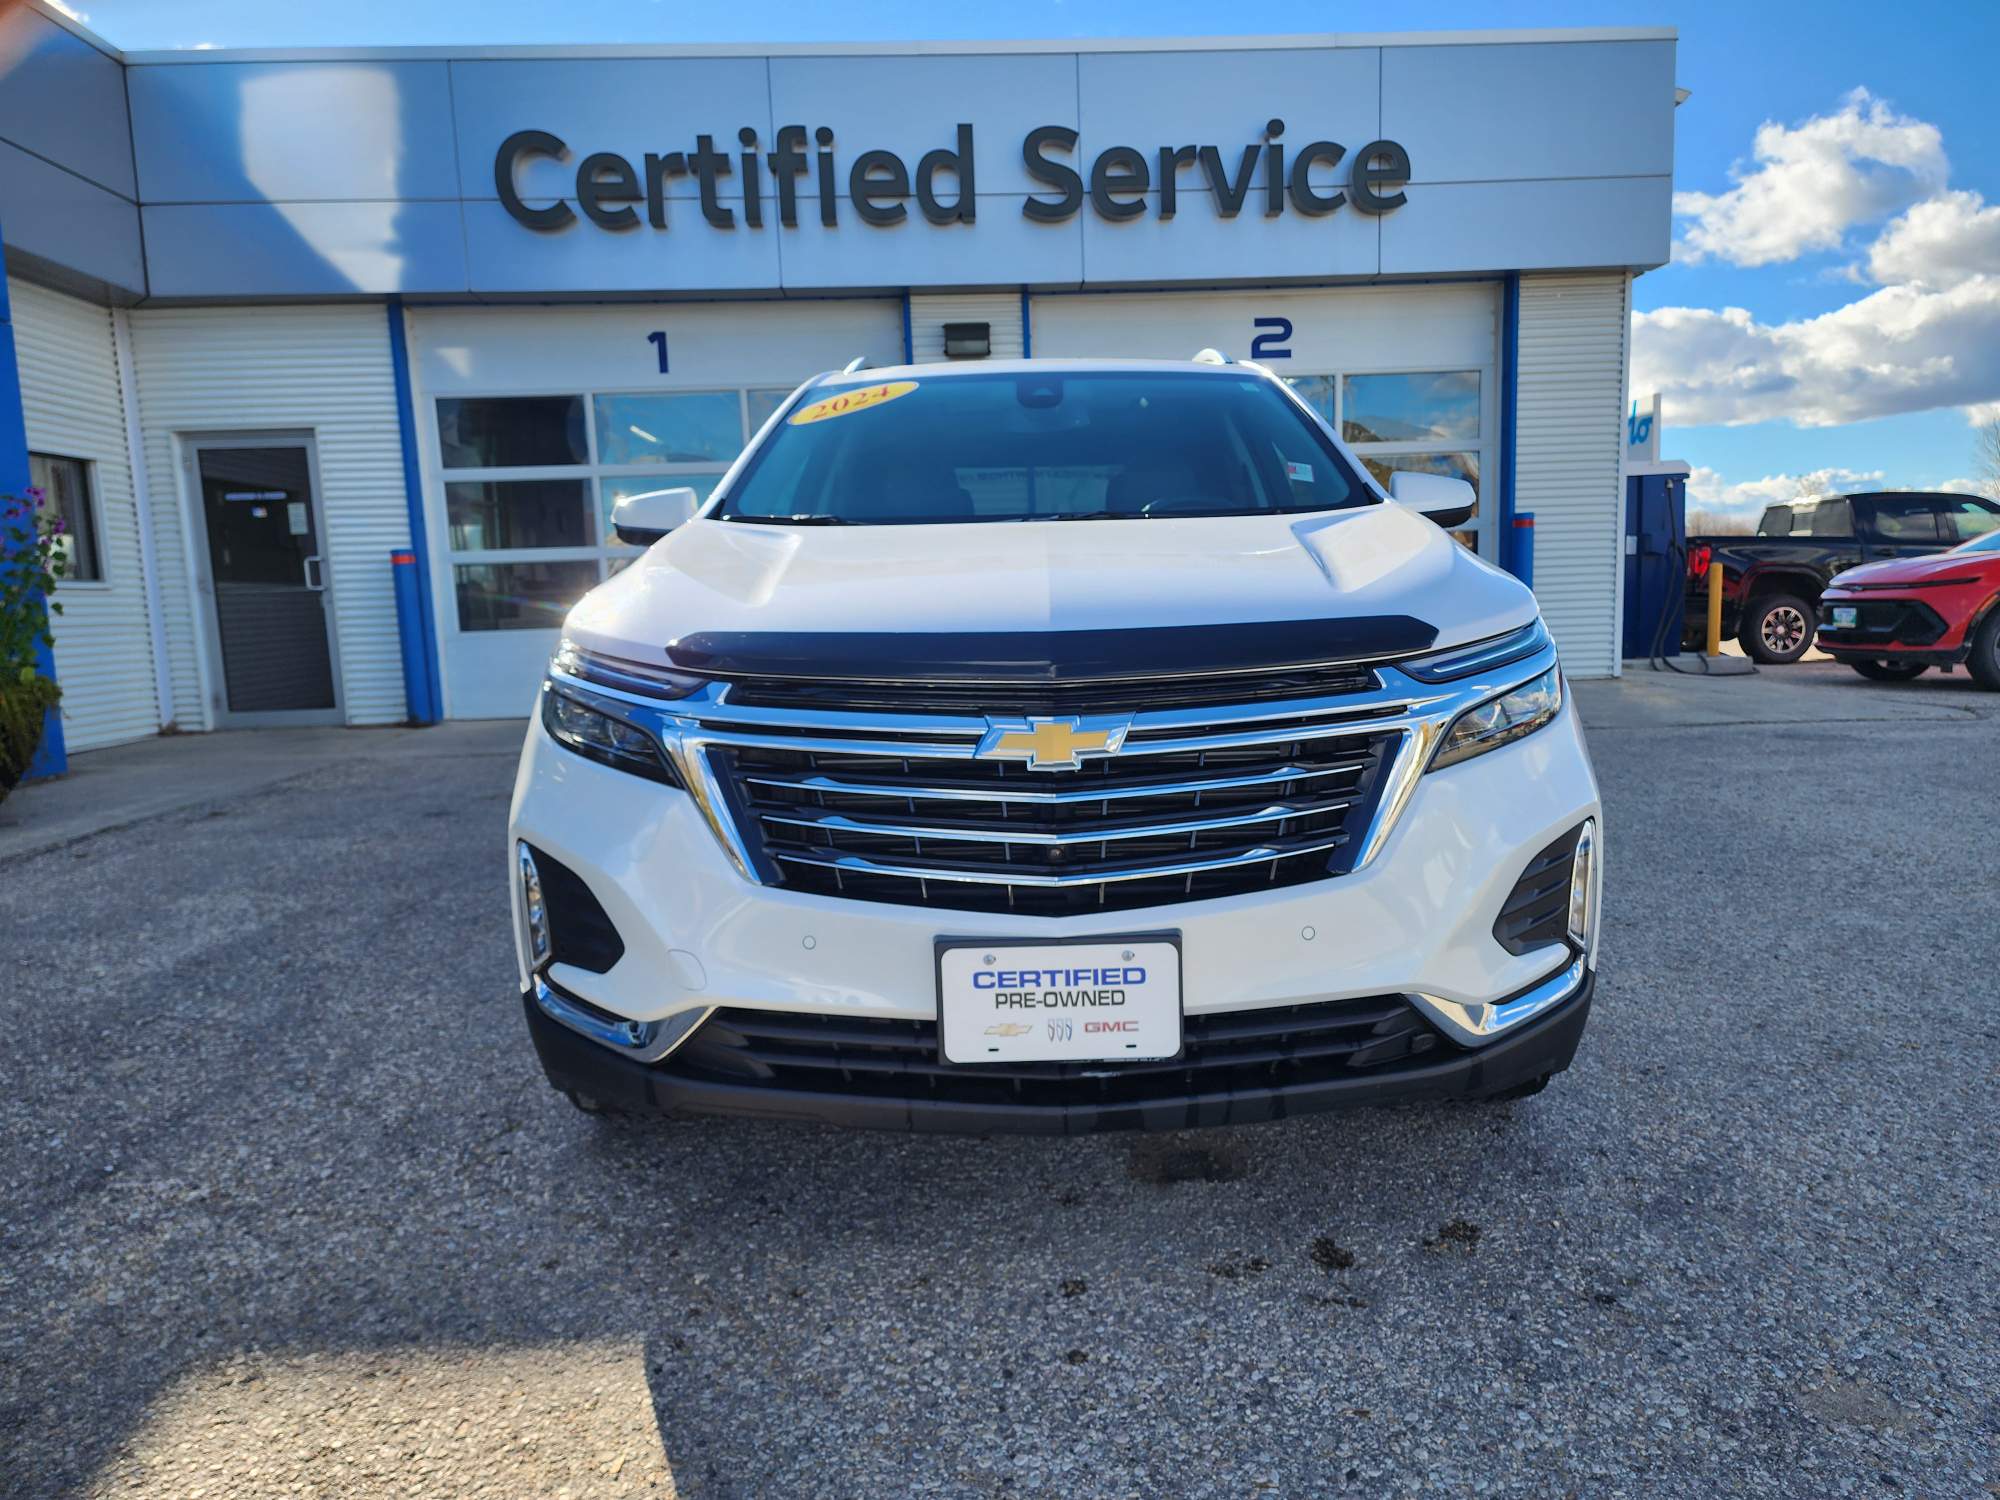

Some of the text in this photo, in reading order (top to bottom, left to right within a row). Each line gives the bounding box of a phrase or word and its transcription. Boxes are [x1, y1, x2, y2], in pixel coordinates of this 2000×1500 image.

[495, 118, 1411, 231] Certified Service
[647, 331, 669, 374] 1
[1251, 317, 1293, 359] 2
[812, 386, 890, 419] 2024
[973, 967, 1147, 989] CERTIFIED
[995, 990, 1126, 1009] PRE-OWNED
[1084, 1020, 1140, 1033] GMC
